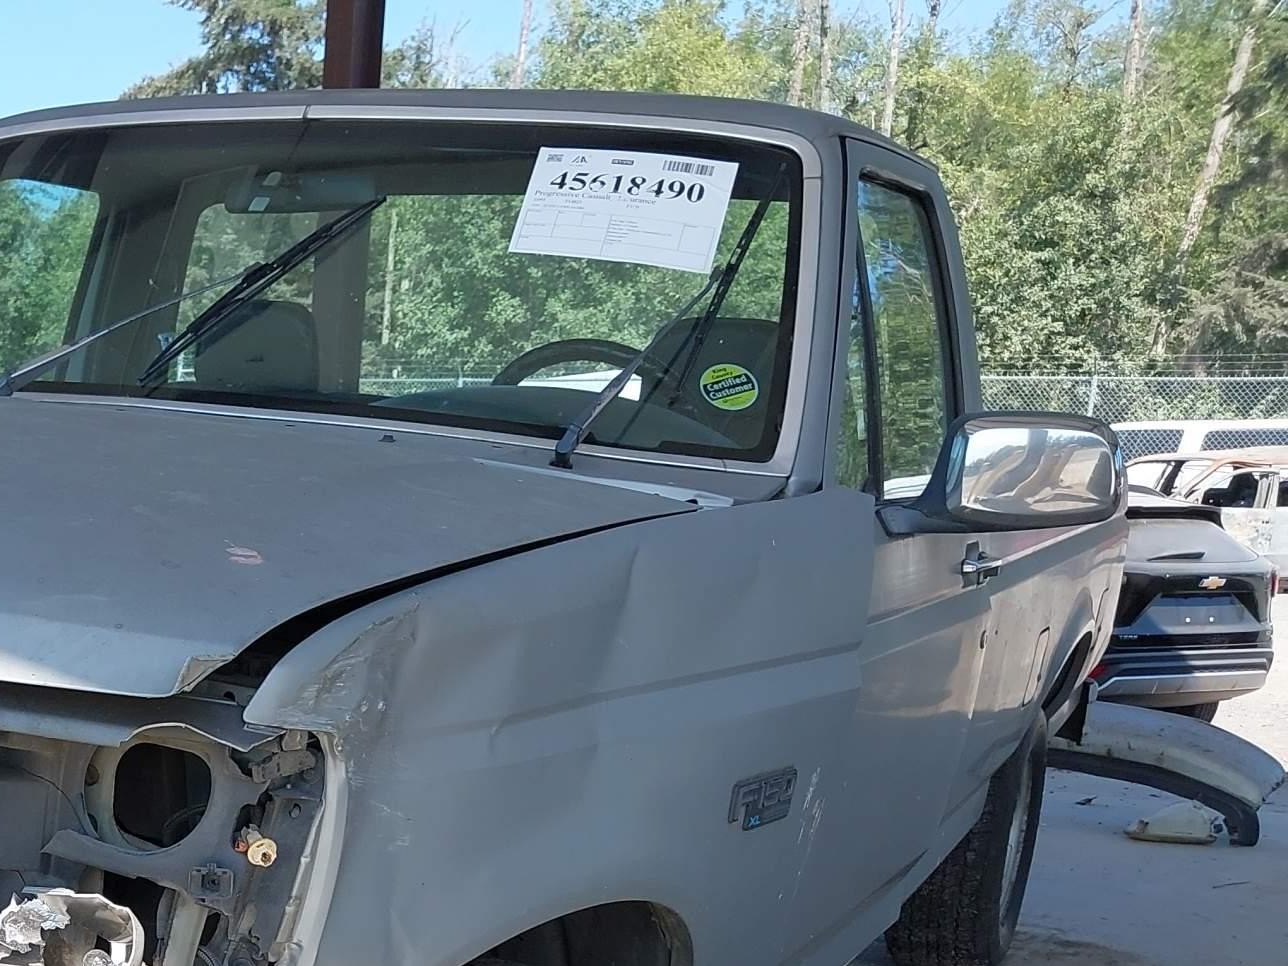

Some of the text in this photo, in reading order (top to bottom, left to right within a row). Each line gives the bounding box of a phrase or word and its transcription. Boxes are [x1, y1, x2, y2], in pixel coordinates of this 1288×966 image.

[550, 170, 705, 203] 45618490
[707, 374, 747, 391] Certified
[709, 383, 753, 399] Customer
